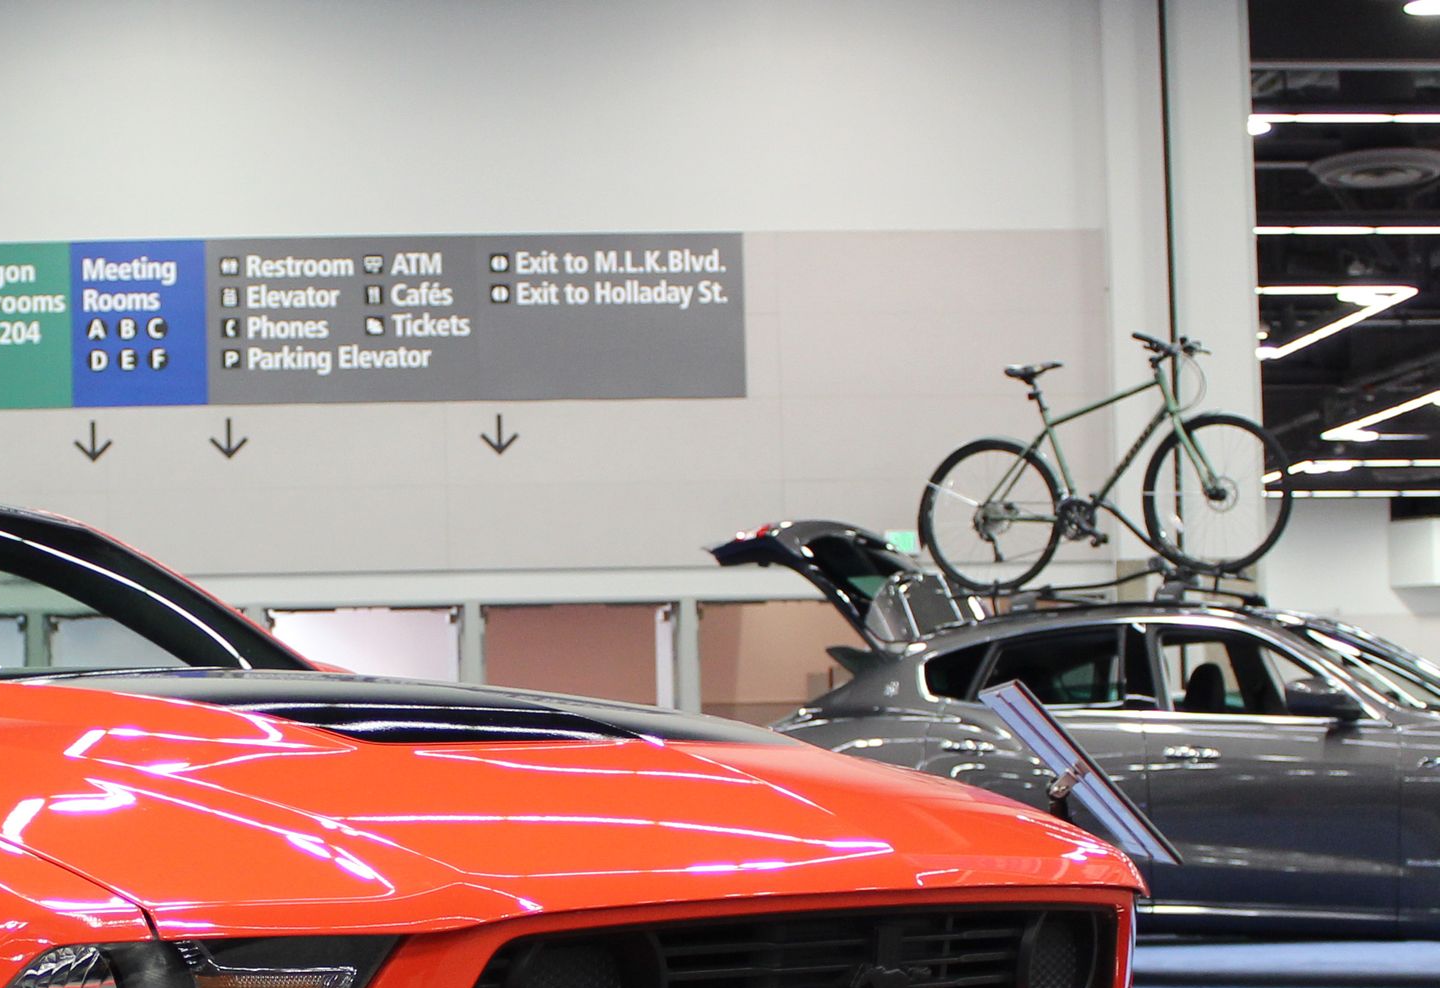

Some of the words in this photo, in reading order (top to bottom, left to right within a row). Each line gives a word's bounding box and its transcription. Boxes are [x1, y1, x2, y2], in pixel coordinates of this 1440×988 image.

[82, 255, 177, 286] Meeting
[246, 255, 355, 278] Restroom
[390, 252, 442, 275] ATM
[515, 250, 559, 274] Exit
[563, 253, 589, 274] to
[82, 288, 161, 312] Rooms
[246, 285, 340, 309] Elevator
[390, 281, 454, 307] Cafés
[516, 281, 559, 305] Exit
[563, 283, 590, 305] to
[594, 281, 694, 310] Holladay
[698, 280, 728, 304] St.
[88, 318, 106, 339] A
[120, 318, 135, 340] B
[147, 317, 163, 339] C
[247, 316, 329, 339] Phones
[391, 313, 471, 337] Tickets
[91, 350, 108, 371] D
[121, 349, 134, 370] E
[152, 348, 165, 369] F
[247, 347, 332, 375] Parking
[338, 345, 432, 369] Elevator
